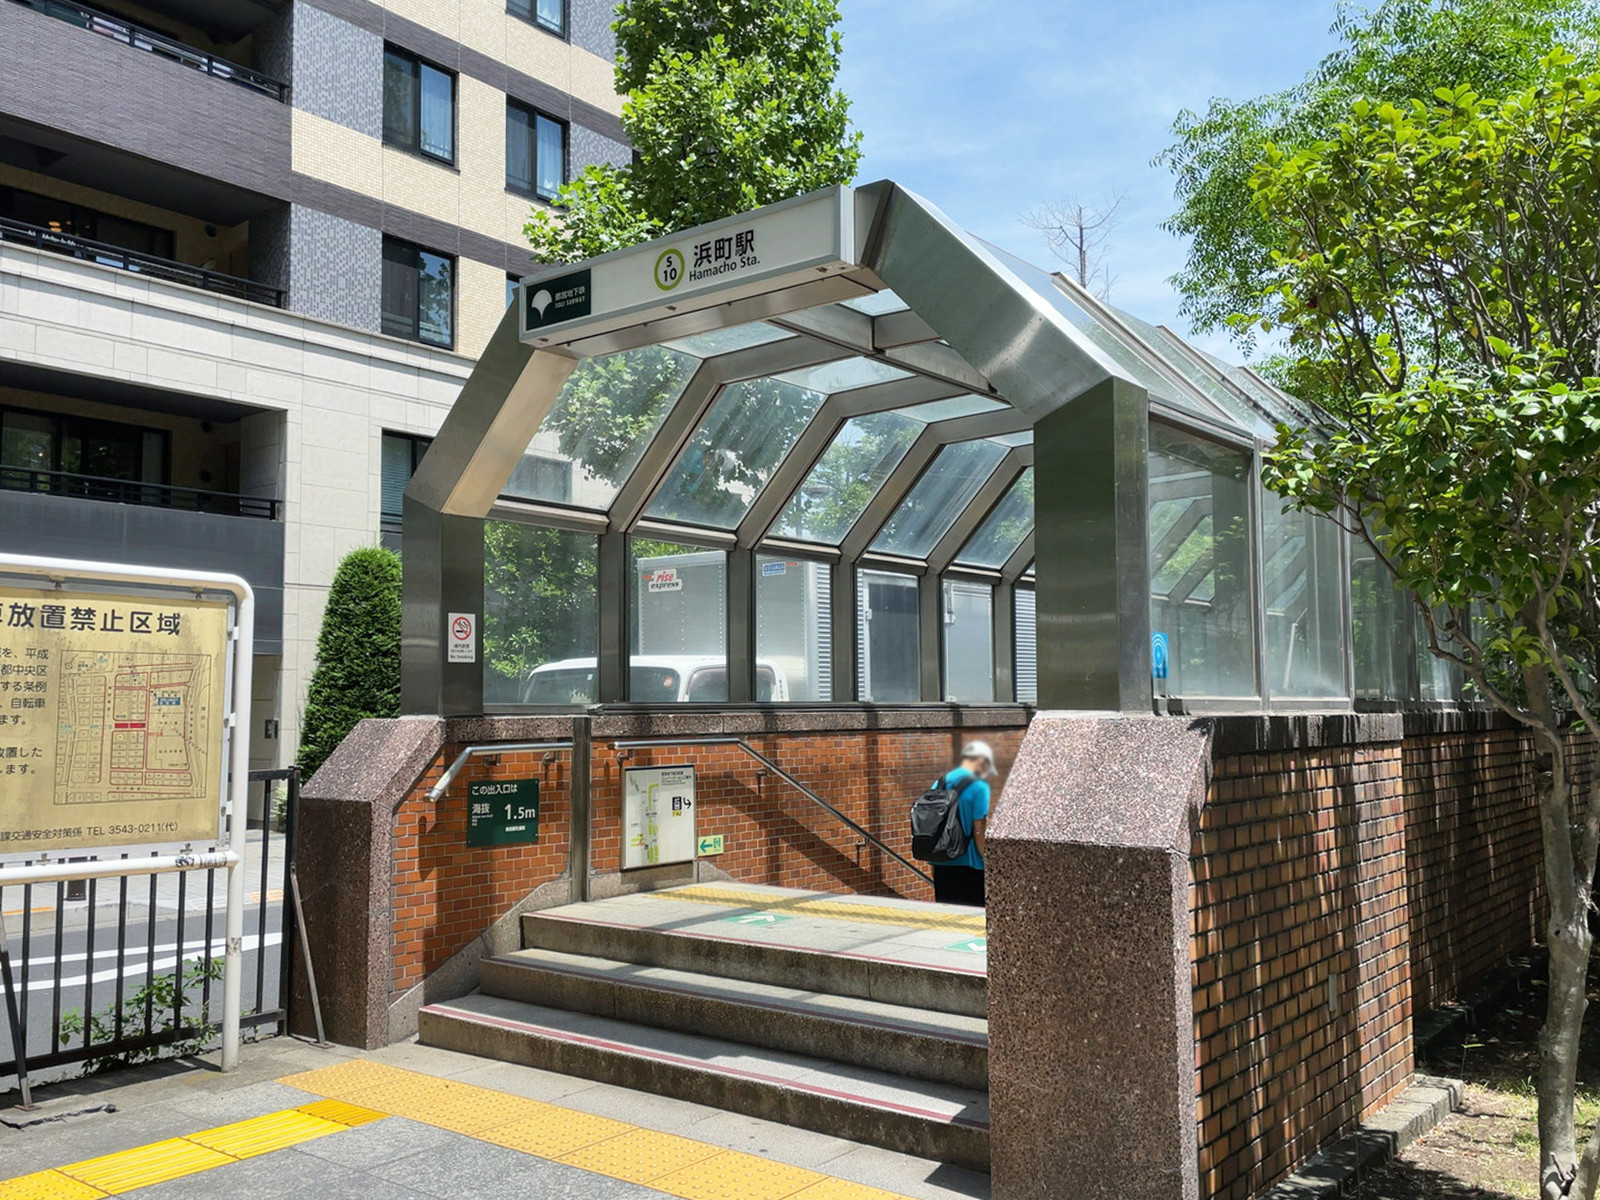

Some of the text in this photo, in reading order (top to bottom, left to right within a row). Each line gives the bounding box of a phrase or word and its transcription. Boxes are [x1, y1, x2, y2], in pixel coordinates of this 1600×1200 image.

[693, 229, 755, 268] 浜町駅
[666, 256, 673, 268] S
[663, 268, 678, 282] 10
[689, 256, 761, 282] Hamacho Sta.
[656, 571, 674, 582] rise
[650, 581, 679, 590] express
[0, 602, 181, 636] 放置禁止区域
[0, 647, 49, 660] を、平成
[471, 784, 518, 795] この出入口は
[471, 802, 490, 814] 海抜
[504, 804, 536, 820] 1.5m
[87, 826, 105, 836] TEL
